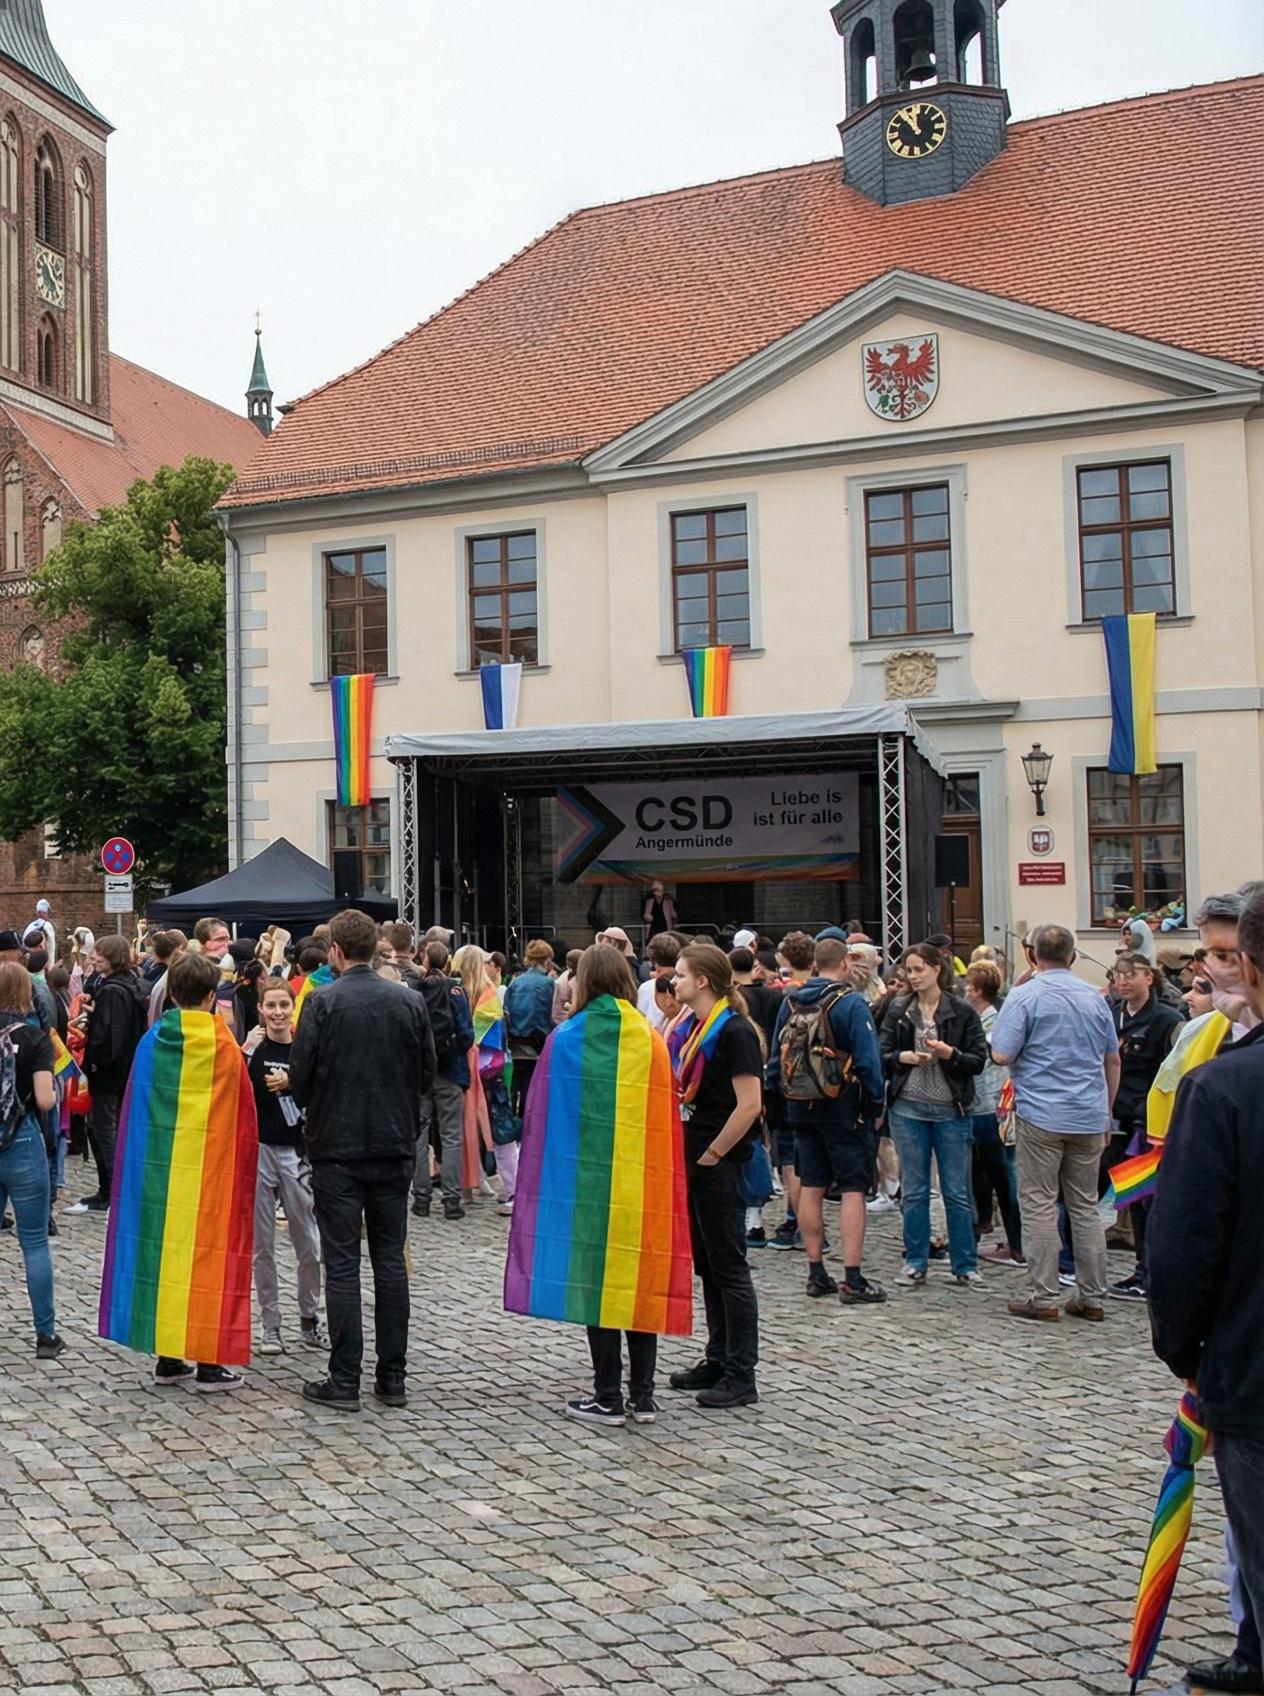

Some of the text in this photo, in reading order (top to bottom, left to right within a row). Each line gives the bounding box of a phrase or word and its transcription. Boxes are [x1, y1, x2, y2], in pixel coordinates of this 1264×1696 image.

[771, 789, 842, 806] Liebe is
[635, 795, 733, 832] CSD
[753, 809, 843, 826] ist für alle
[635, 835, 733, 851] Angermünde
